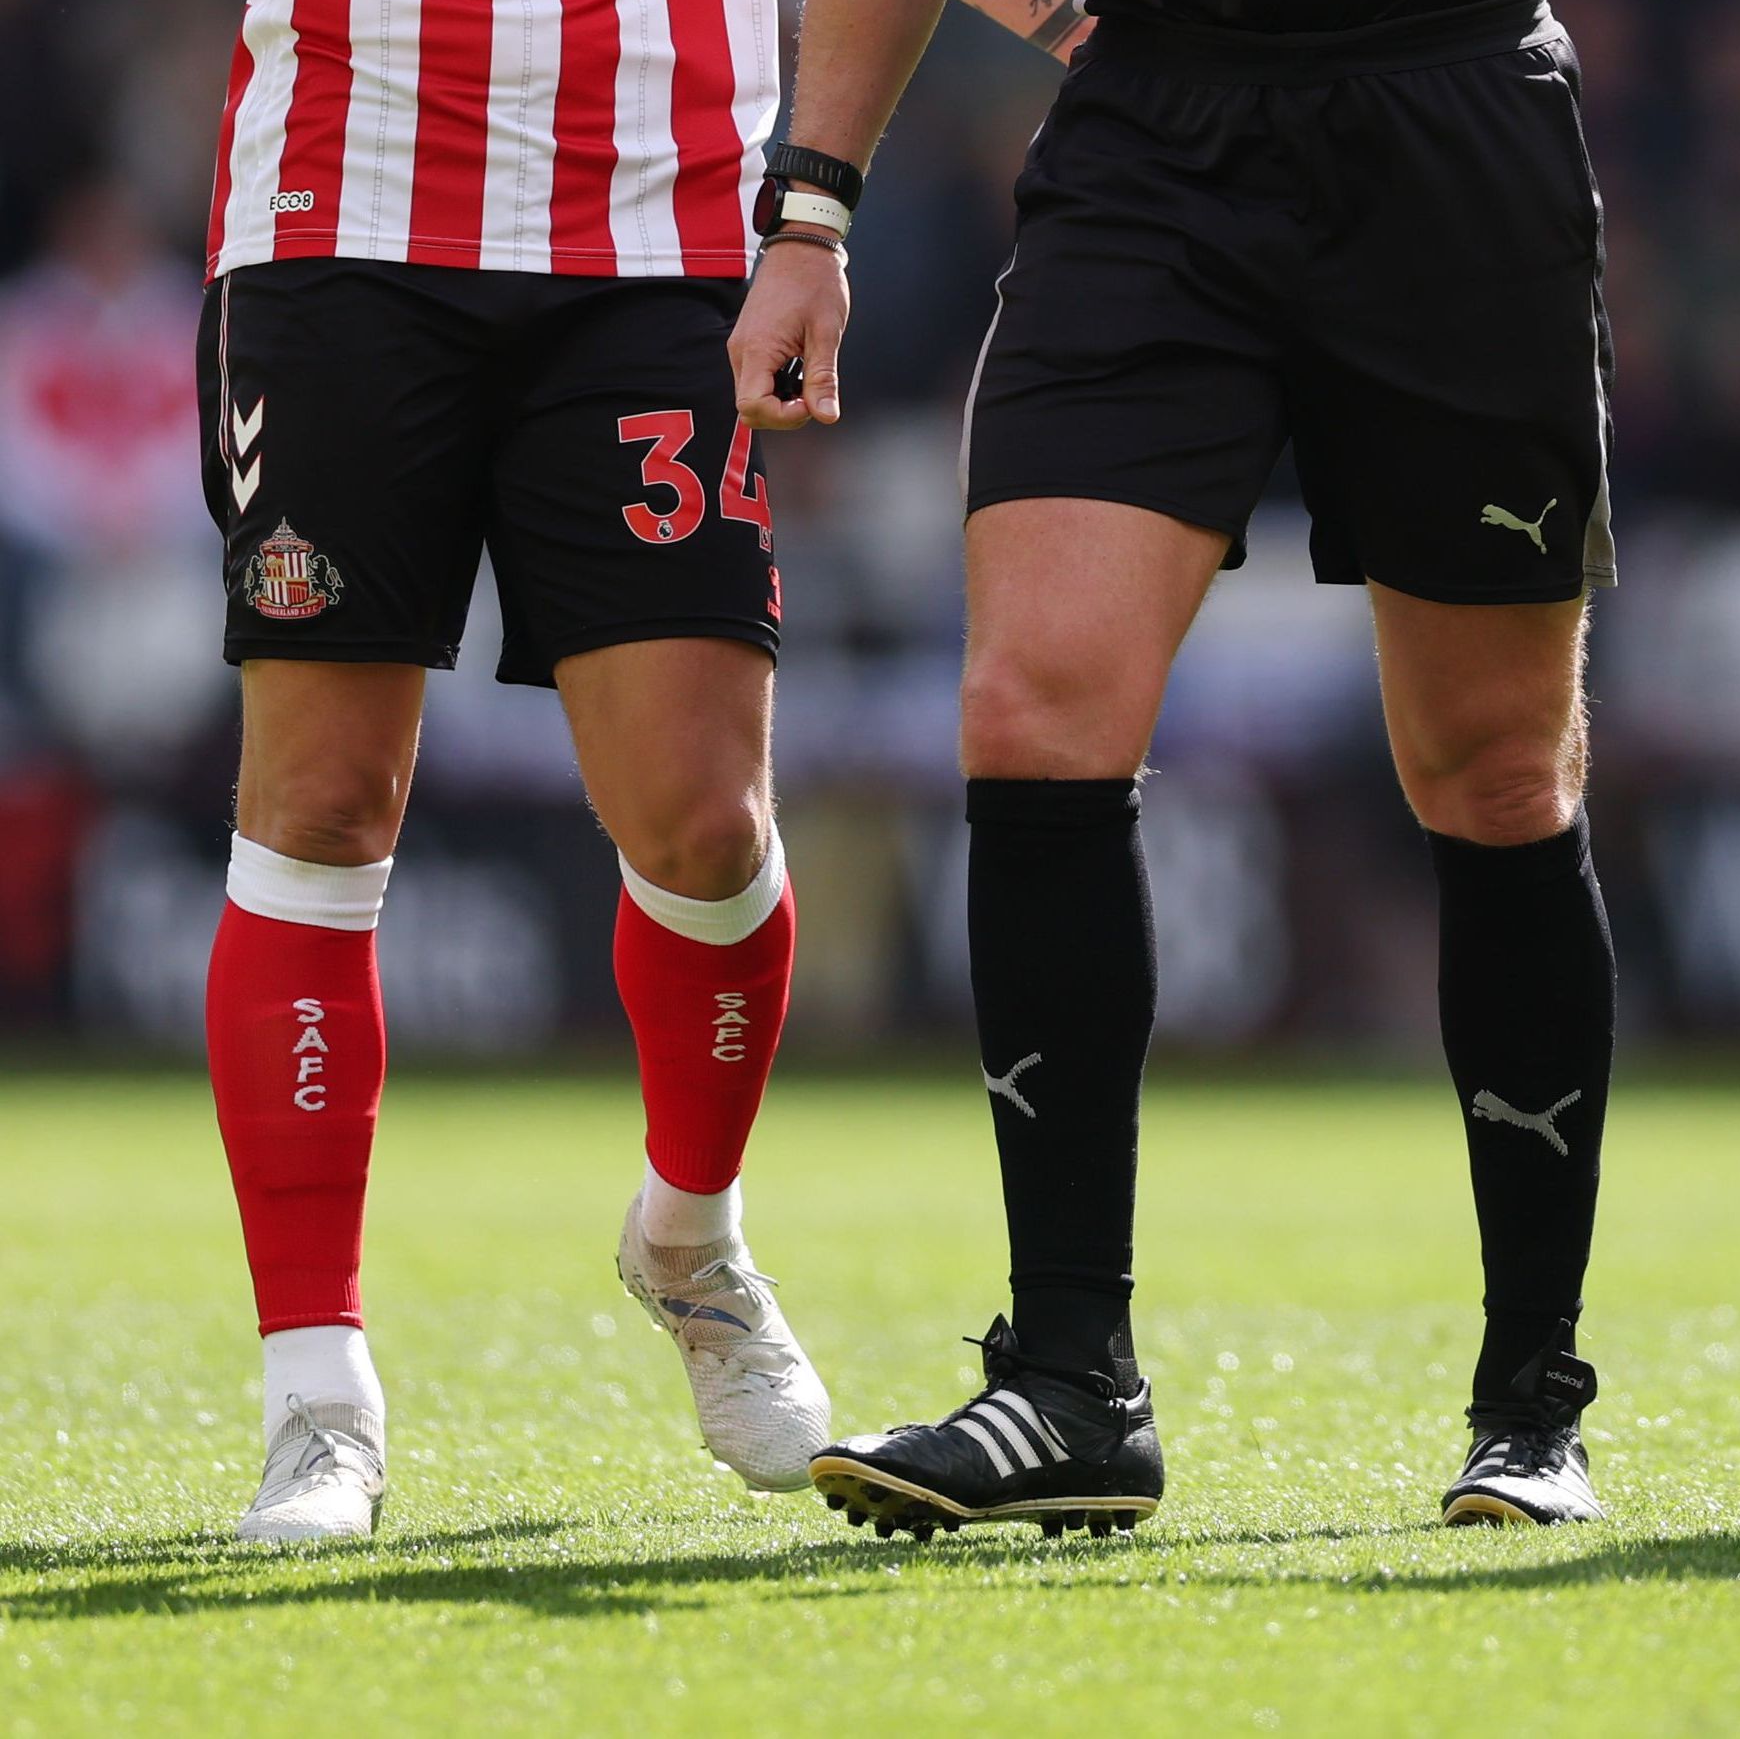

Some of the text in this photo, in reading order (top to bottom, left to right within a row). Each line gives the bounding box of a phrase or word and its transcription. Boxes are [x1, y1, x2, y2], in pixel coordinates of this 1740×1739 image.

[617, 409, 773, 553] 34
[291, 997, 330, 1112] SAFC
[711, 991, 751, 1062] SAFC
